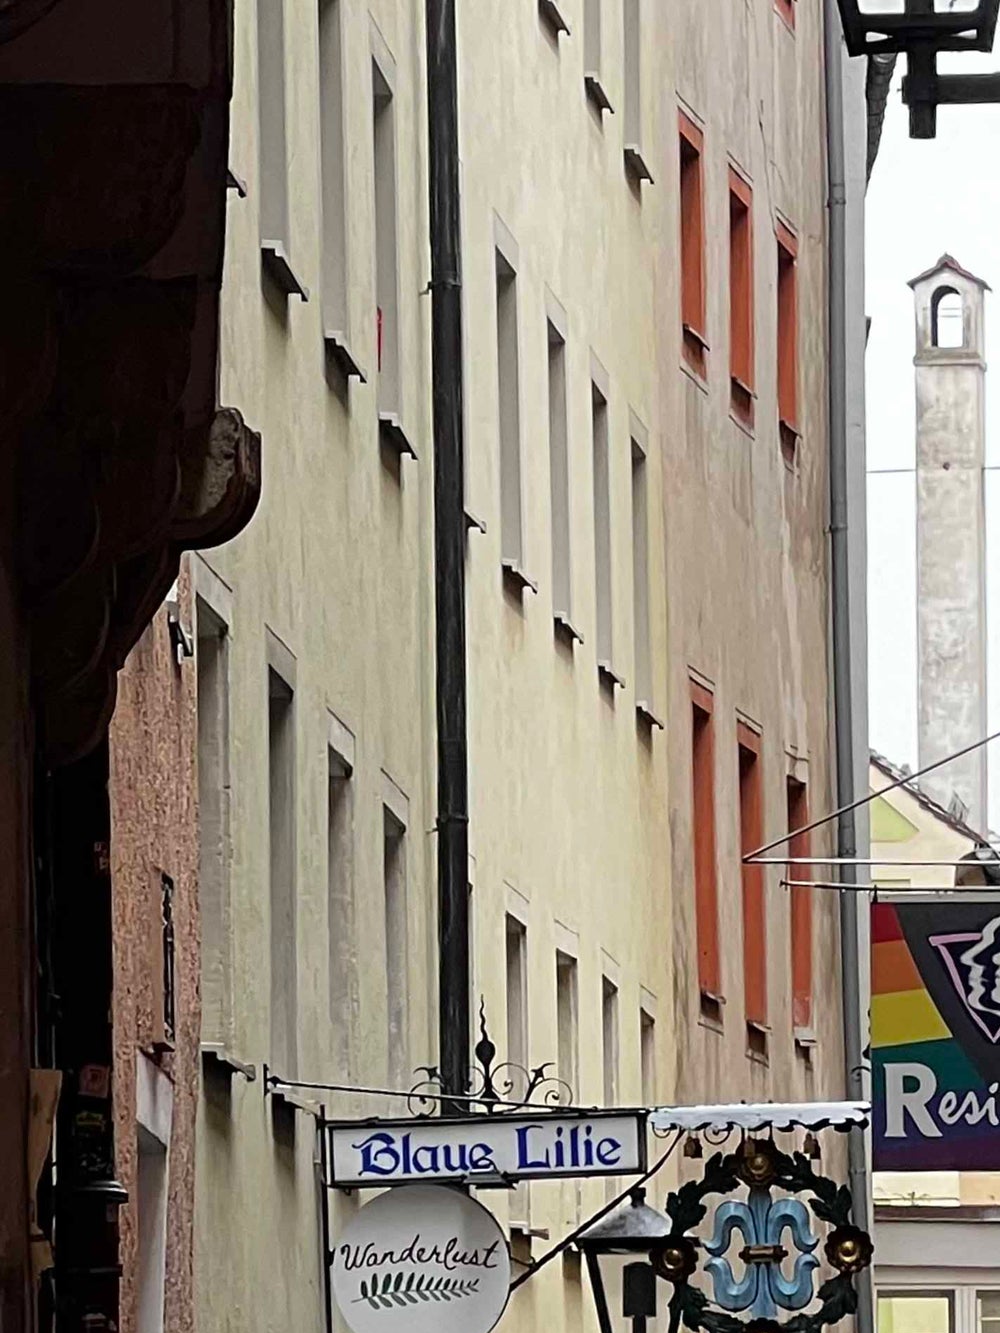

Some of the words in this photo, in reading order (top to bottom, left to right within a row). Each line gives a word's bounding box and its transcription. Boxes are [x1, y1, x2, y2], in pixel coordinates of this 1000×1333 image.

[882, 1062, 1000, 1138] Resi
[351, 1132, 494, 1177] Blaue
[514, 1124, 622, 1170] Lilie
[339, 1233, 500, 1271] Wanderlust
